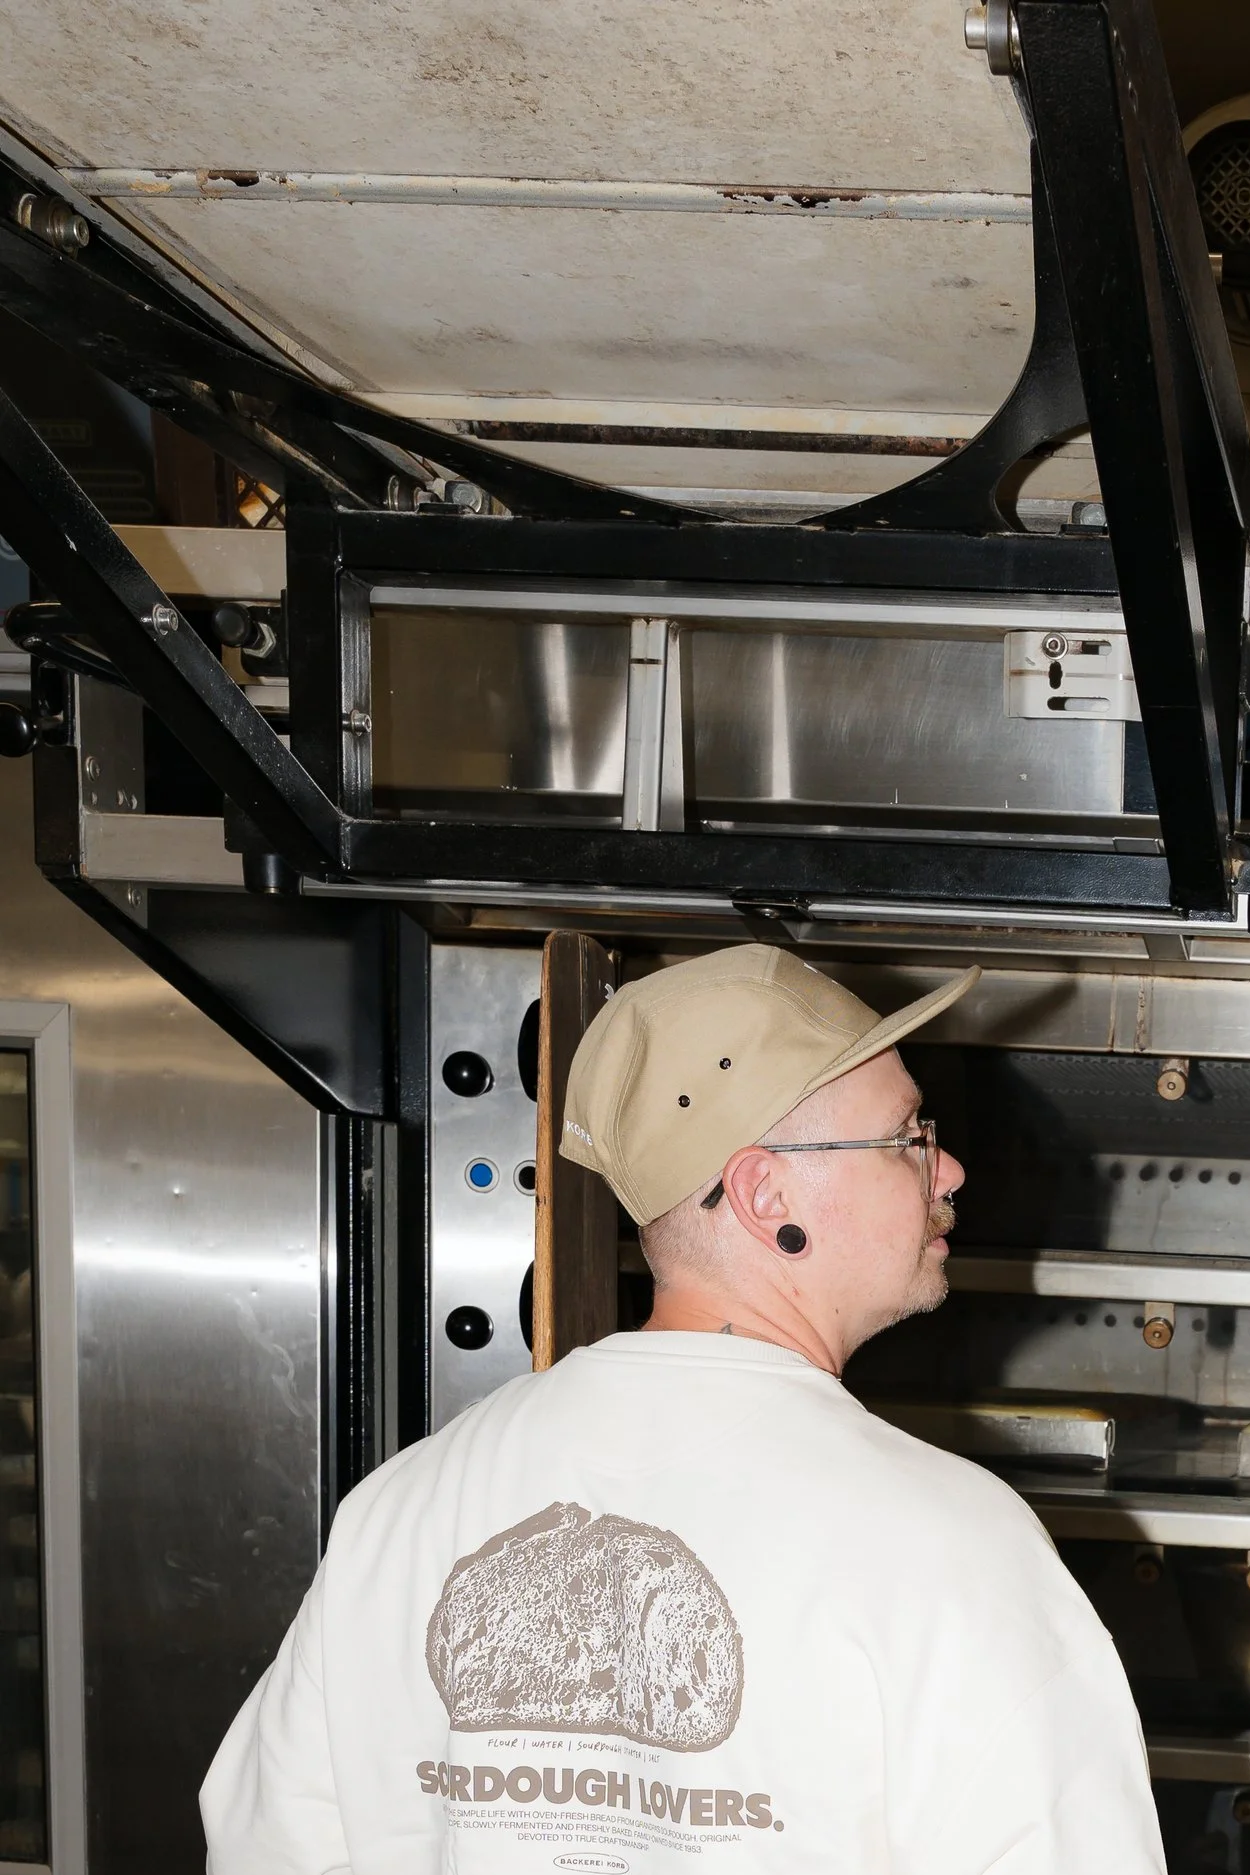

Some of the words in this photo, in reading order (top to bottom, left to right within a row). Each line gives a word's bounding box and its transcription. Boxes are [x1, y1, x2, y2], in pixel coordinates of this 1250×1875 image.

[487, 1738, 518, 1748] FLOUR
[531, 1740, 564, 1749] WATER
[416, 1760, 630, 1810] SORDOUGH
[638, 1777, 785, 1833] LOVERS.
[456, 1809, 486, 1819] SIMPLE
[487, 1809, 506, 1819] LIFE
[507, 1810, 531, 1819] WITH
[532, 1810, 589, 1821] OVEN-FRESH
[590, 1812, 617, 1823] BREAD
[617, 1816, 635, 1827] FROM
[699, 1833, 742, 1843] ORIGINAL
[462, 1820, 497, 1830] SLOWLY
[499, 1821, 554, 1831] FERMENTED
[554, 1822, 574, 1832] AND
[575, 1823, 611, 1833] FRESHLY
[517, 1832, 559, 1842] DEVOTED
[560, 1833, 573, 1842] TO
[575, 1834, 597, 1844] TRUE
